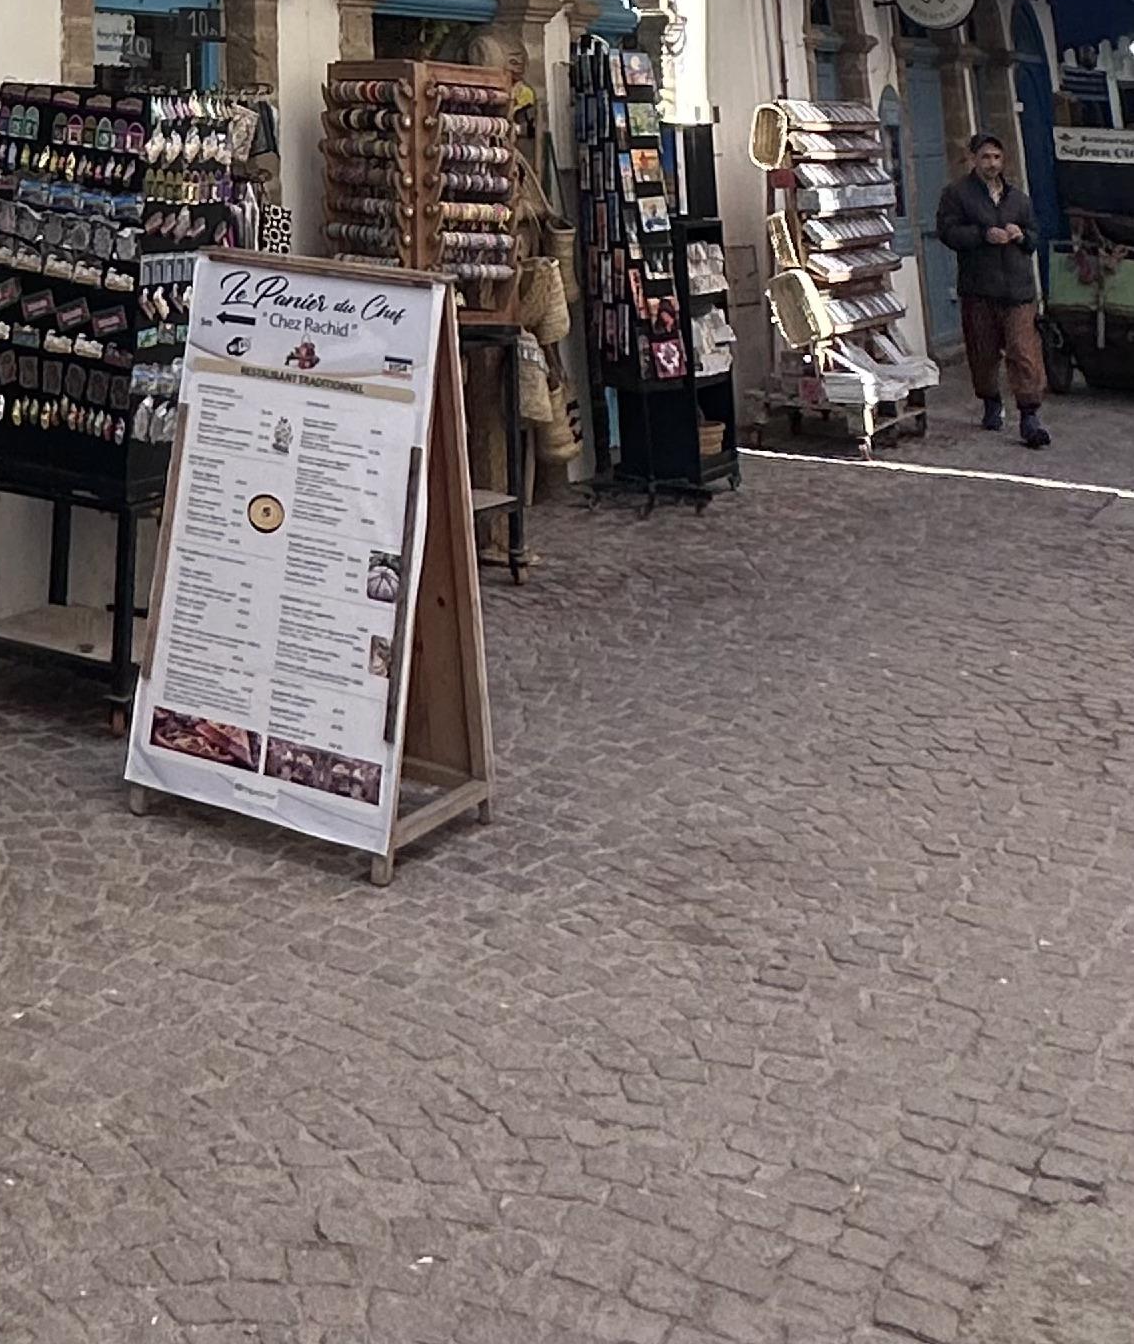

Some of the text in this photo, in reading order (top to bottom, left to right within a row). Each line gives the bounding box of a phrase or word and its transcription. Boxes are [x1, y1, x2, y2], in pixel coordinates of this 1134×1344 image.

[188, 10, 208, 36] 10
[220, 270, 408, 326] Le Panier du Chef
[269, 312, 302, 331] Chez
[304, 317, 350, 338] Rachid
[241, 365, 298, 384] RESTAURANT
